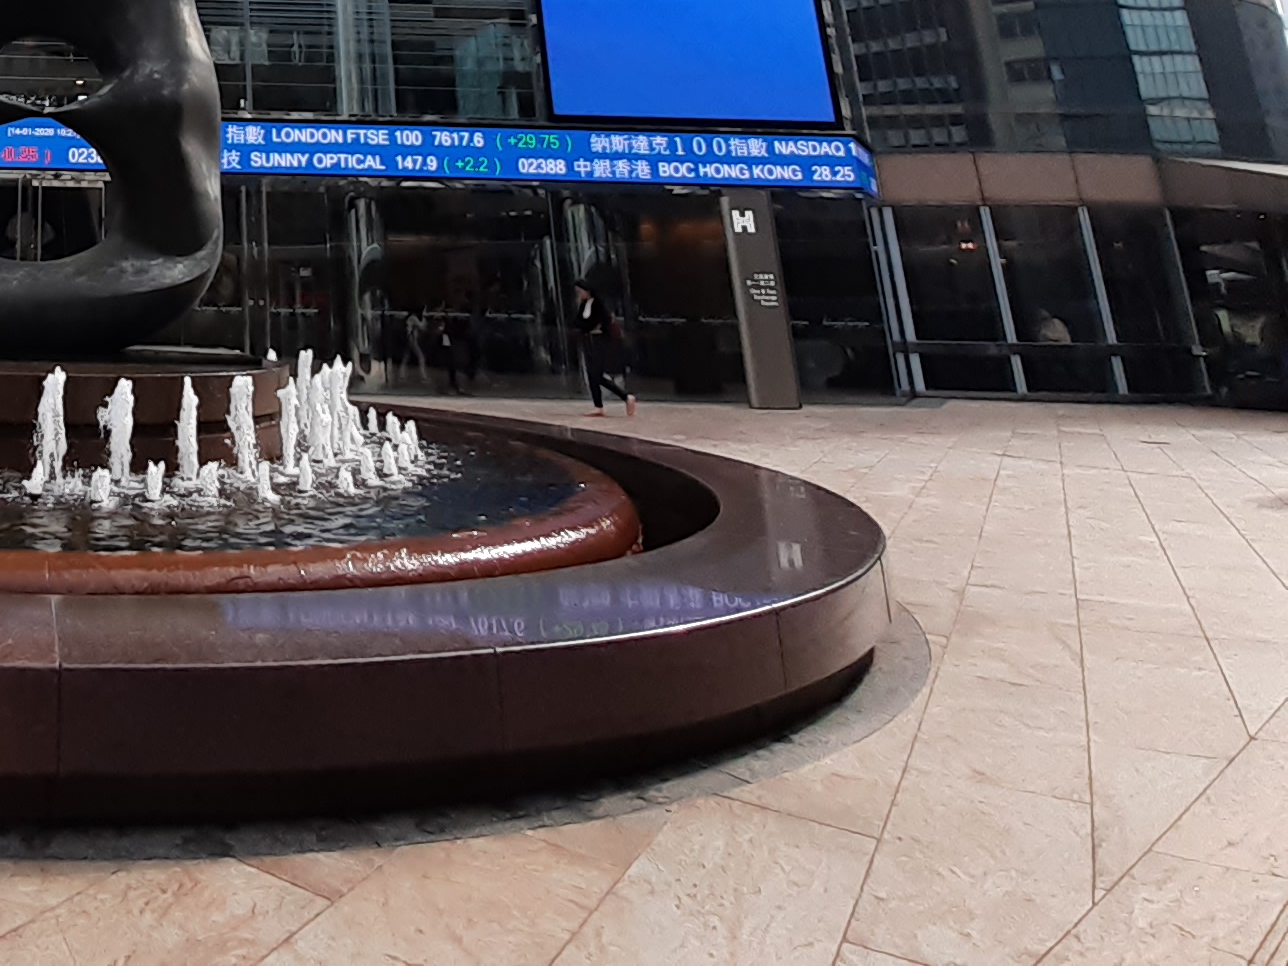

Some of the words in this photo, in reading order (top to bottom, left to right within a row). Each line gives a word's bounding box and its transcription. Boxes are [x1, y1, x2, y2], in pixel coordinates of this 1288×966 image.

[272, 127, 343, 144] LONDON
[347, 129, 390, 145] FTSE
[395, 131, 423, 146] 100
[432, 132, 484, 148] 7617.6
[774, 140, 846, 157] NASDAQ
[250, 152, 309, 168] SUNNY
[313, 153, 386, 170] OPTICAL
[395, 155, 438, 171] 147.9
[518, 158, 567, 174] 02388
[574, 158, 651, 179] 中銀香港
[658, 162, 695, 178] BOC
[699, 163, 750, 179] HONG
[752, 164, 803, 180] KONG
[811, 165, 855, 182] 28.25
